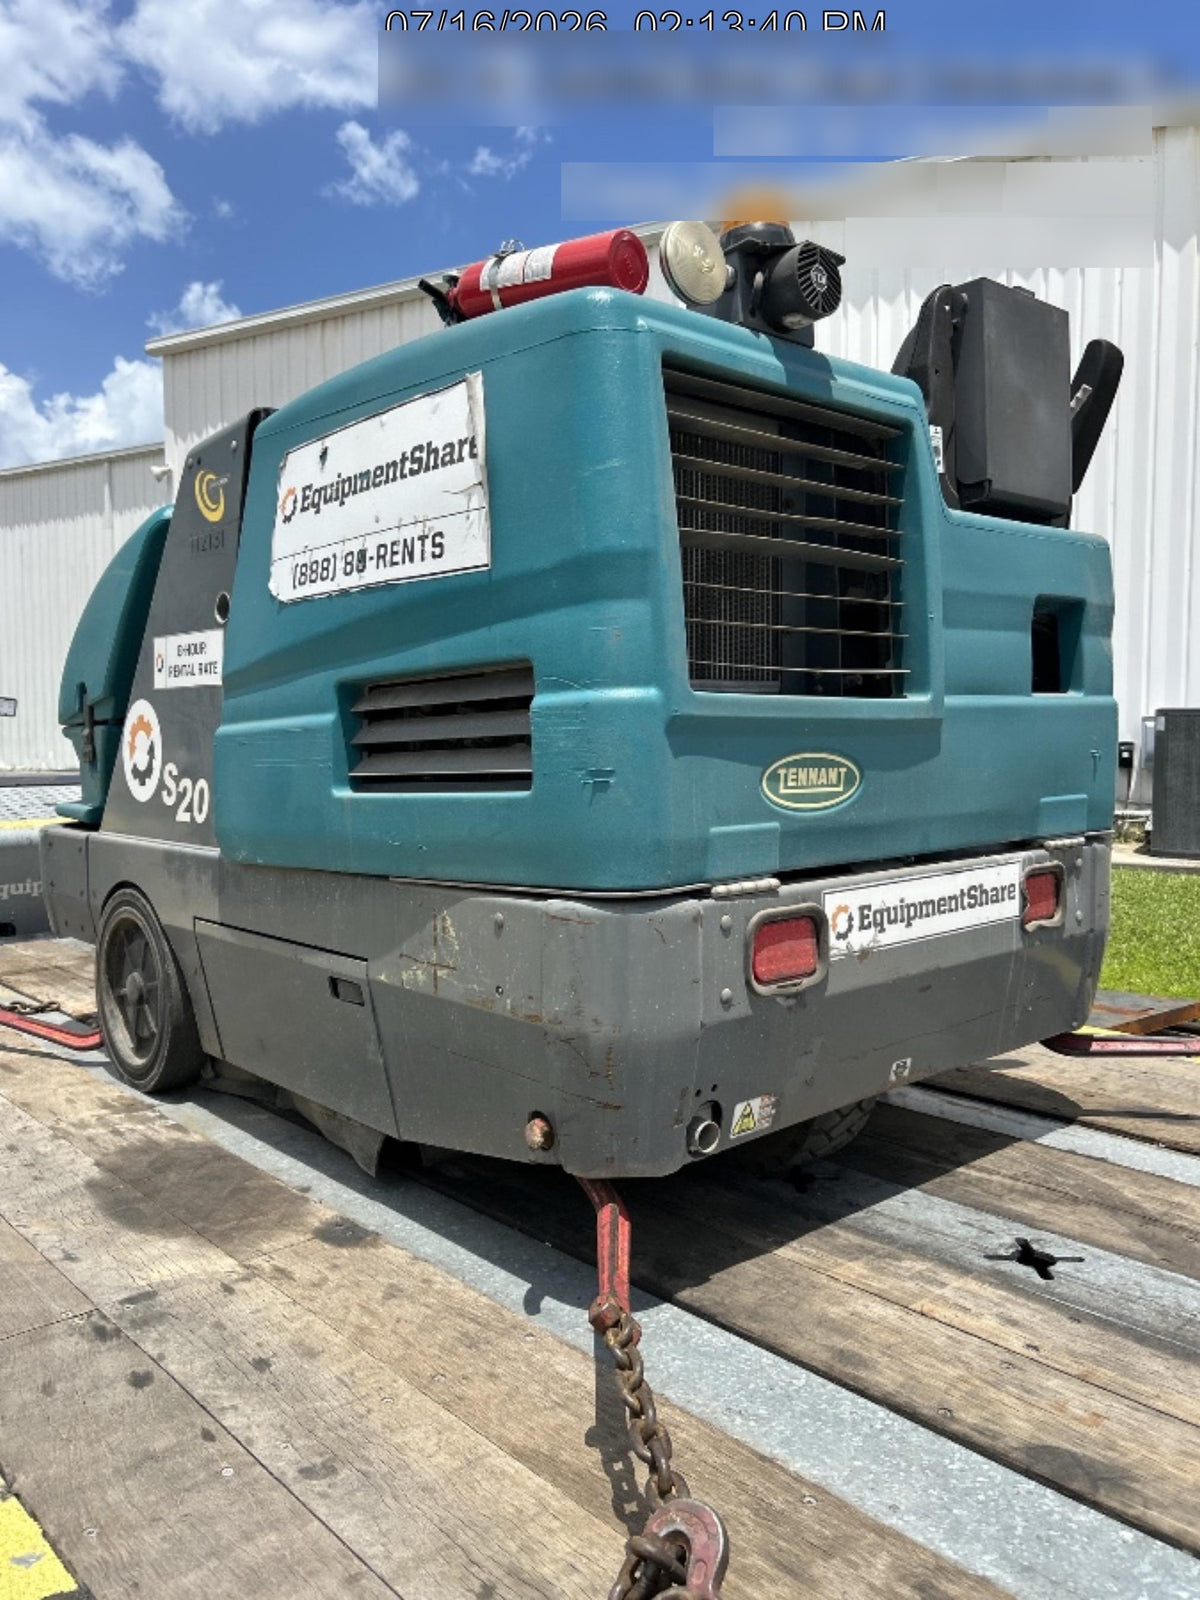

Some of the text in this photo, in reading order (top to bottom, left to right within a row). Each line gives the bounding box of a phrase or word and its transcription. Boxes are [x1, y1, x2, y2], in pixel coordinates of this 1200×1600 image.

[292, 553, 337, 590] (888)
[161, 762, 210, 824] S20
[777, 767, 848, 794] TENNANT
[857, 882, 1016, 933] EquipmentShare
